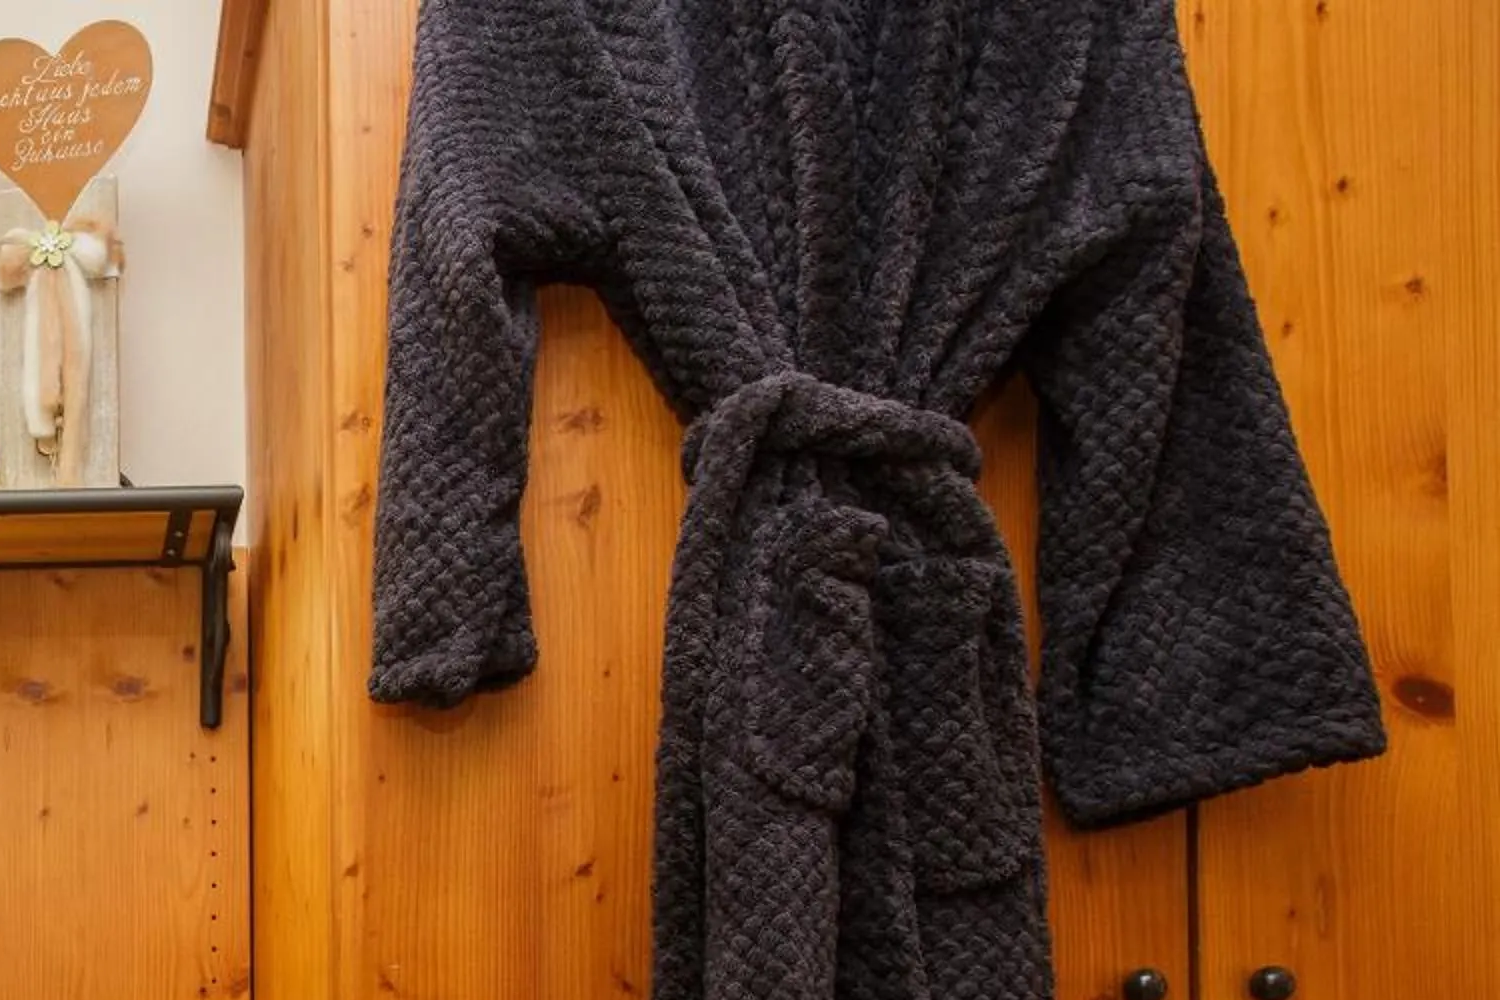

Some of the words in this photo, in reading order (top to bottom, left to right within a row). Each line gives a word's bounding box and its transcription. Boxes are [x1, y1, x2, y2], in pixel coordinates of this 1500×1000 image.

[36, 84, 71, 101] aus
[76, 68, 143, 106] jedem
[19, 102, 91, 133] Haus
[40, 127, 75, 145] ein
